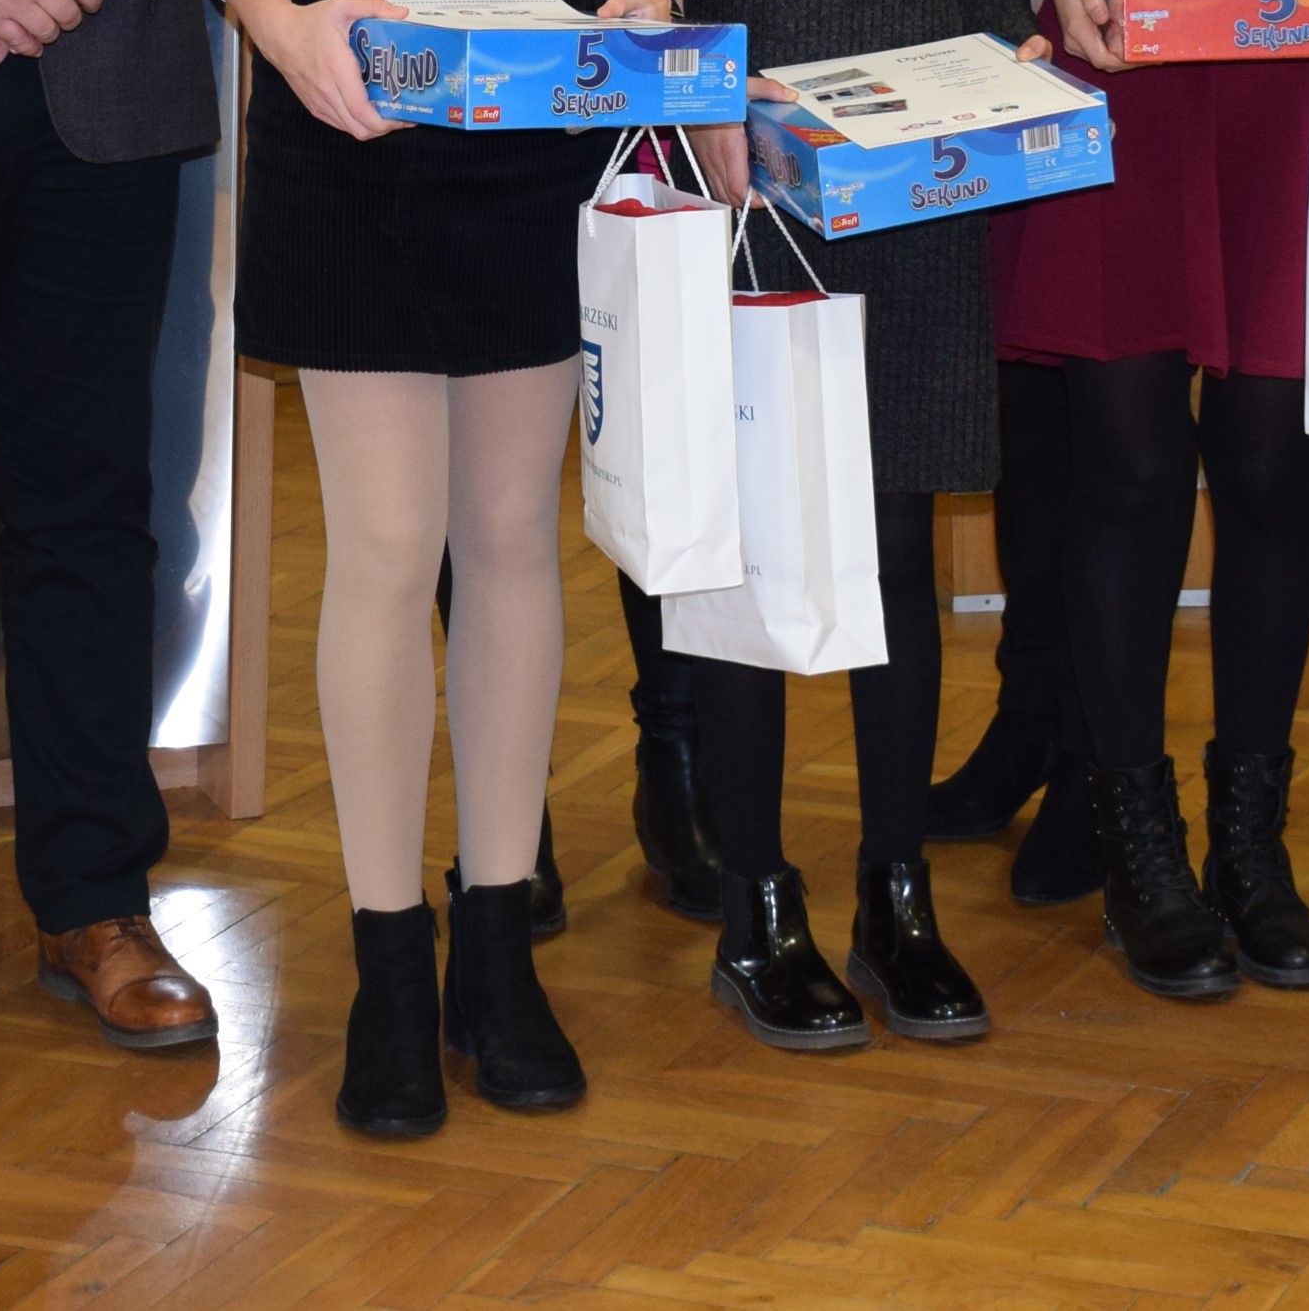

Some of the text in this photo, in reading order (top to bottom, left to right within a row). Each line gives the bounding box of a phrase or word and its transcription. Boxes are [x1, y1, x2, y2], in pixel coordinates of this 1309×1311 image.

[356, 27, 439, 101] SEKUND
[576, 32, 611, 90] 5
[483, 110, 499, 120] Trefl
[551, 85, 628, 119] SEKUND
[932, 133, 968, 181] 5
[911, 177, 989, 210] SEKUND
